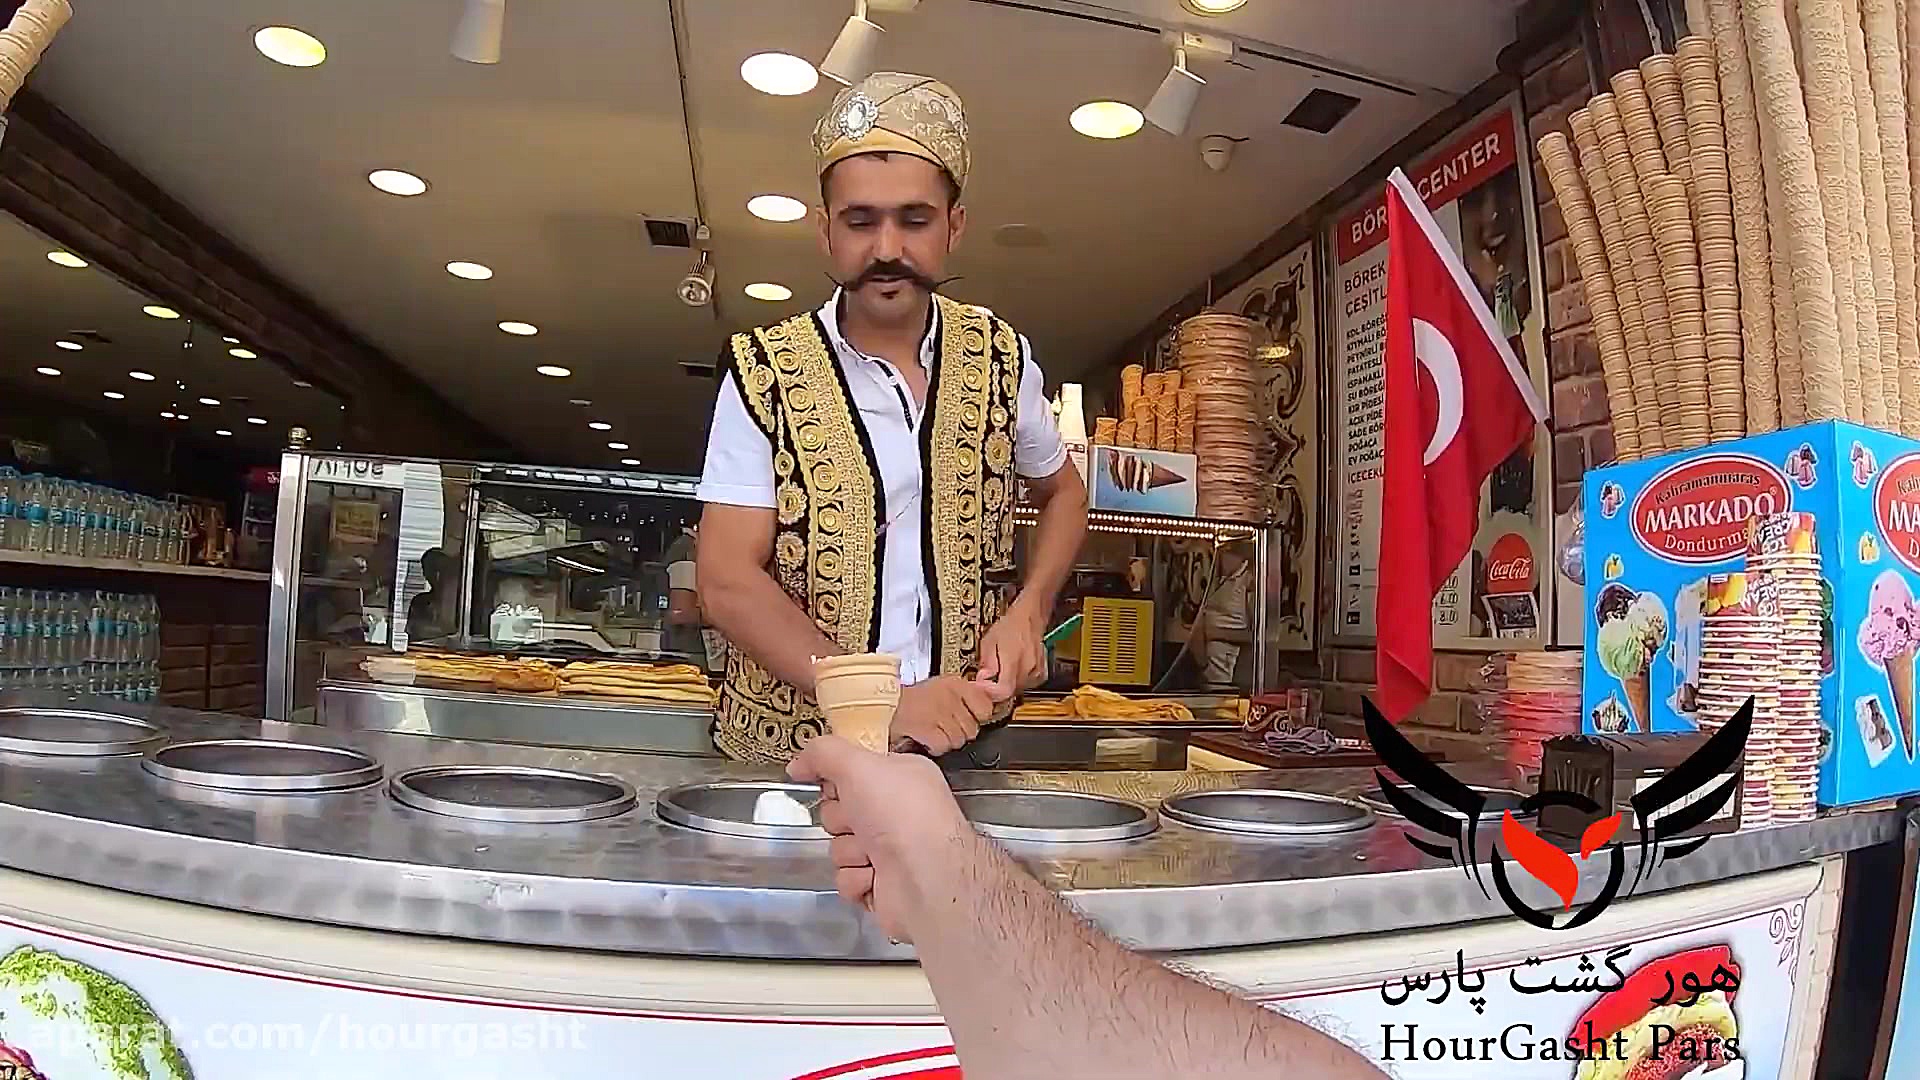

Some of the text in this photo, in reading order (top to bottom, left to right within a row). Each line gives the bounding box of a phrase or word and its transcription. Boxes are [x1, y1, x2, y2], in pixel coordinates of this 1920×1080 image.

[1417, 132, 1501, 201] CENTER
[1344, 260, 1387, 294] BÖREK
[1349, 427, 1367, 440] SADE
[1645, 493, 1776, 533] MARKADO
